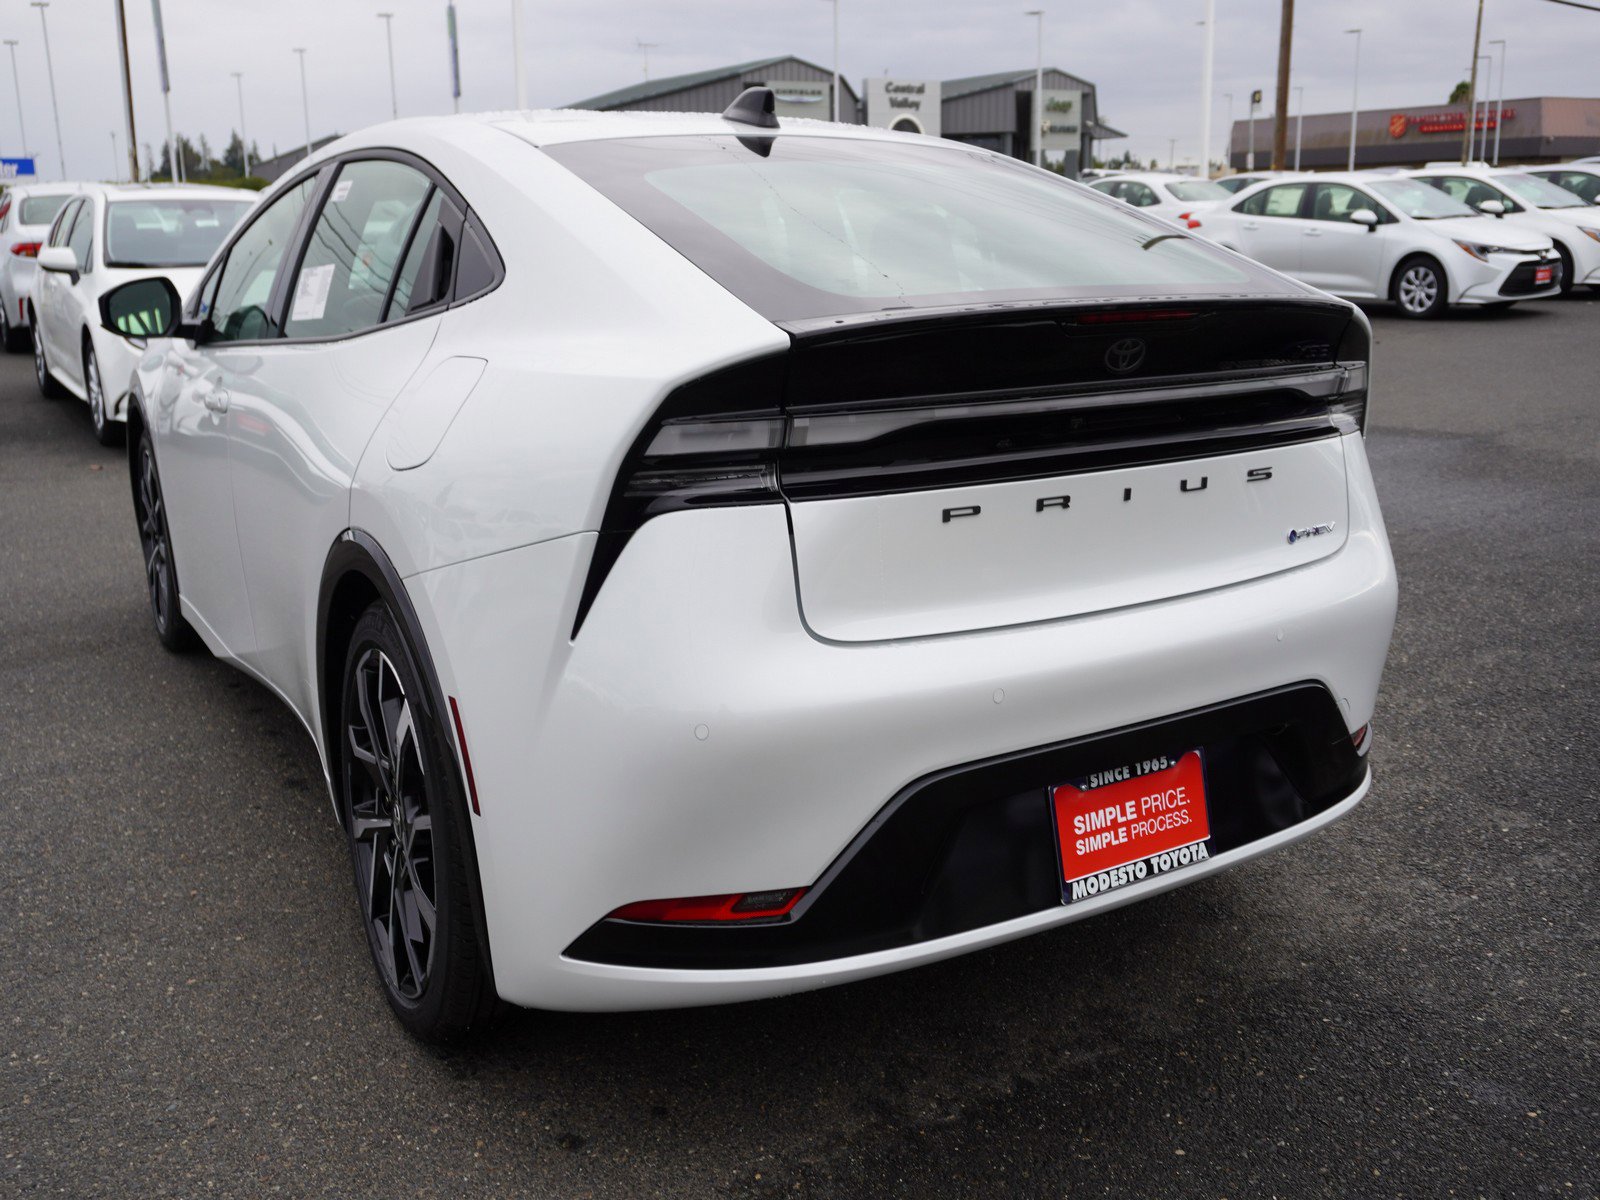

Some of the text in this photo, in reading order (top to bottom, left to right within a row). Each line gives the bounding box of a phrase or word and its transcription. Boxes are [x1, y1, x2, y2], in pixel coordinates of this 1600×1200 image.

[885, 81, 926, 94] Central
[888, 96, 921, 112] Valley
[942, 466, 1273, 523] PRIUS
[1090, 756, 1168, 788] SINCE 1965
[1073, 787, 1191, 835] SIMPLE PRICE.
[1075, 809, 1192, 856] SIMPLE PROCESS.
[1072, 842, 1209, 900] MODESTO TOYOTA
